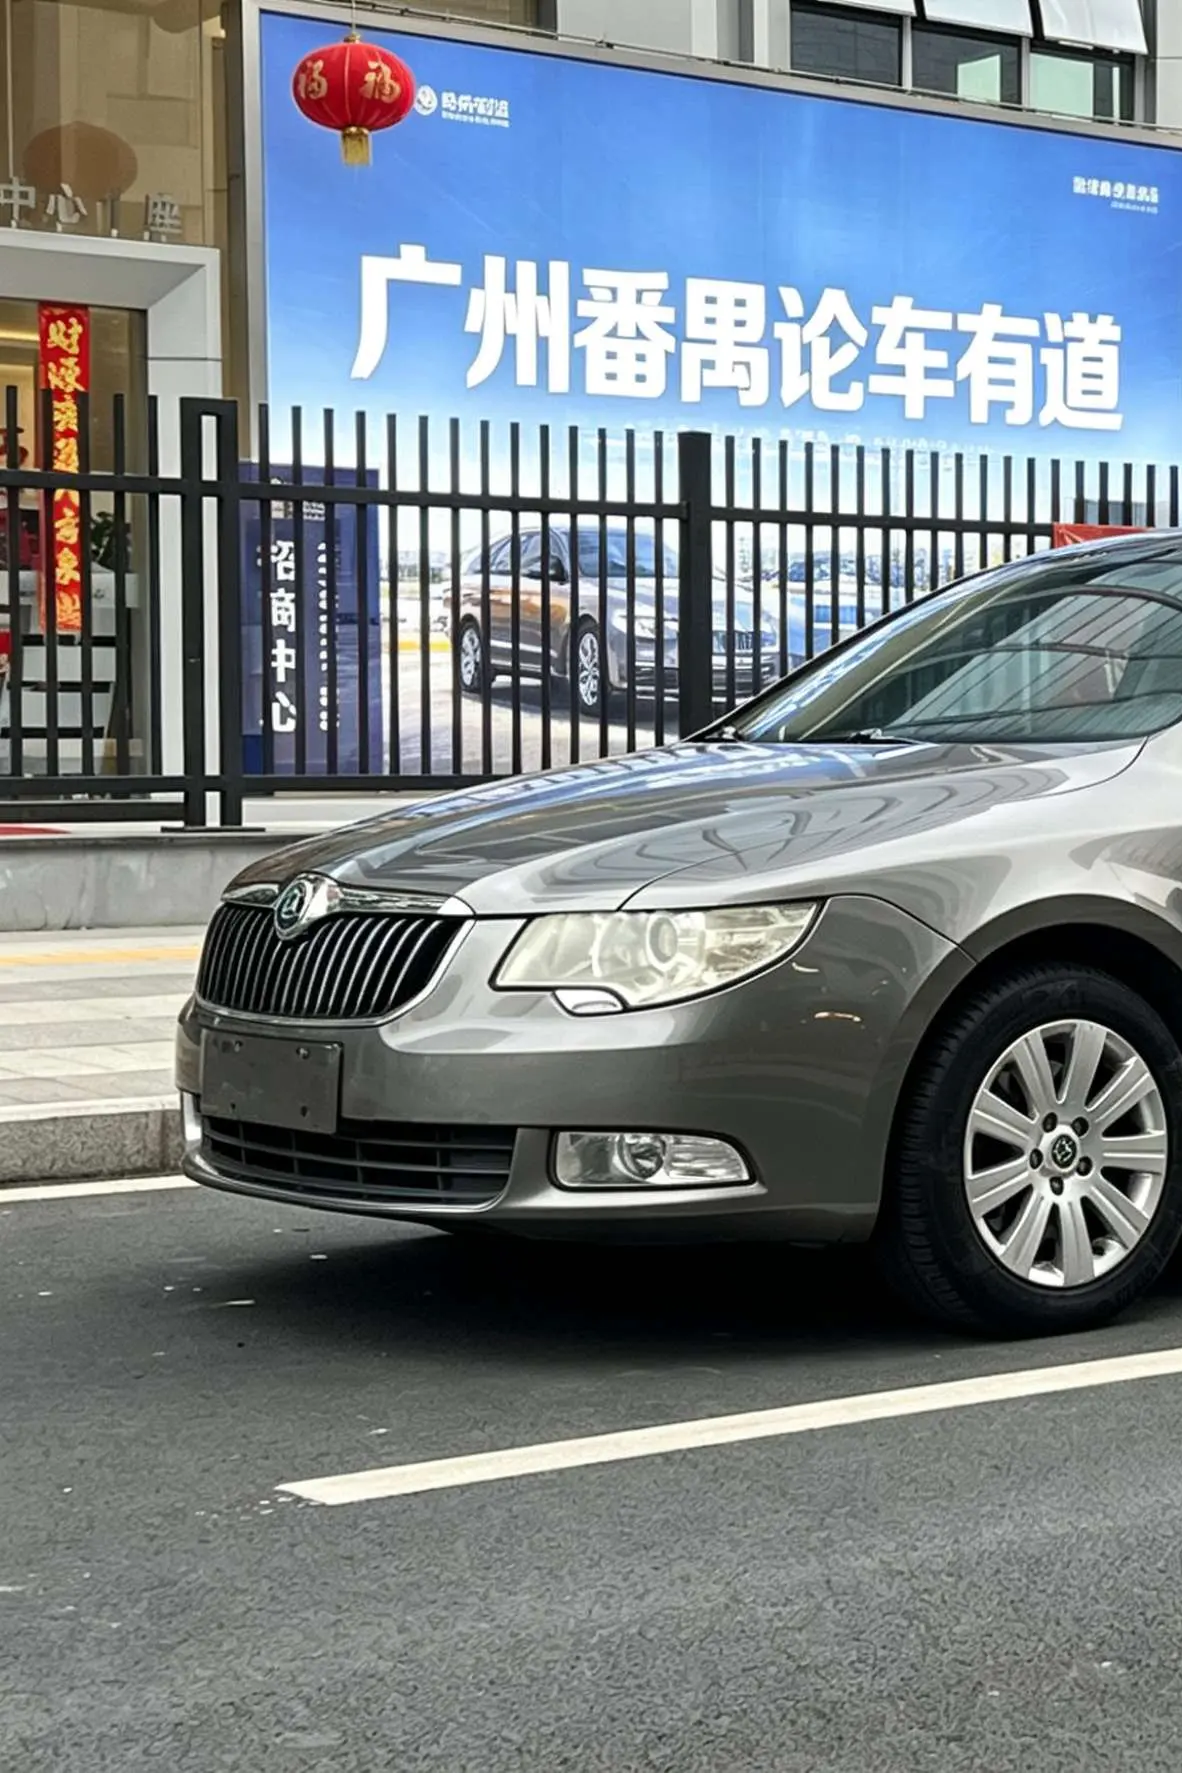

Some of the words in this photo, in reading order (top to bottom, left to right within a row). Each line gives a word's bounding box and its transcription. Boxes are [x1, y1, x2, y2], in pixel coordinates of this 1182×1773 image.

[351, 244, 1123, 431] 广州番禺论车有道
